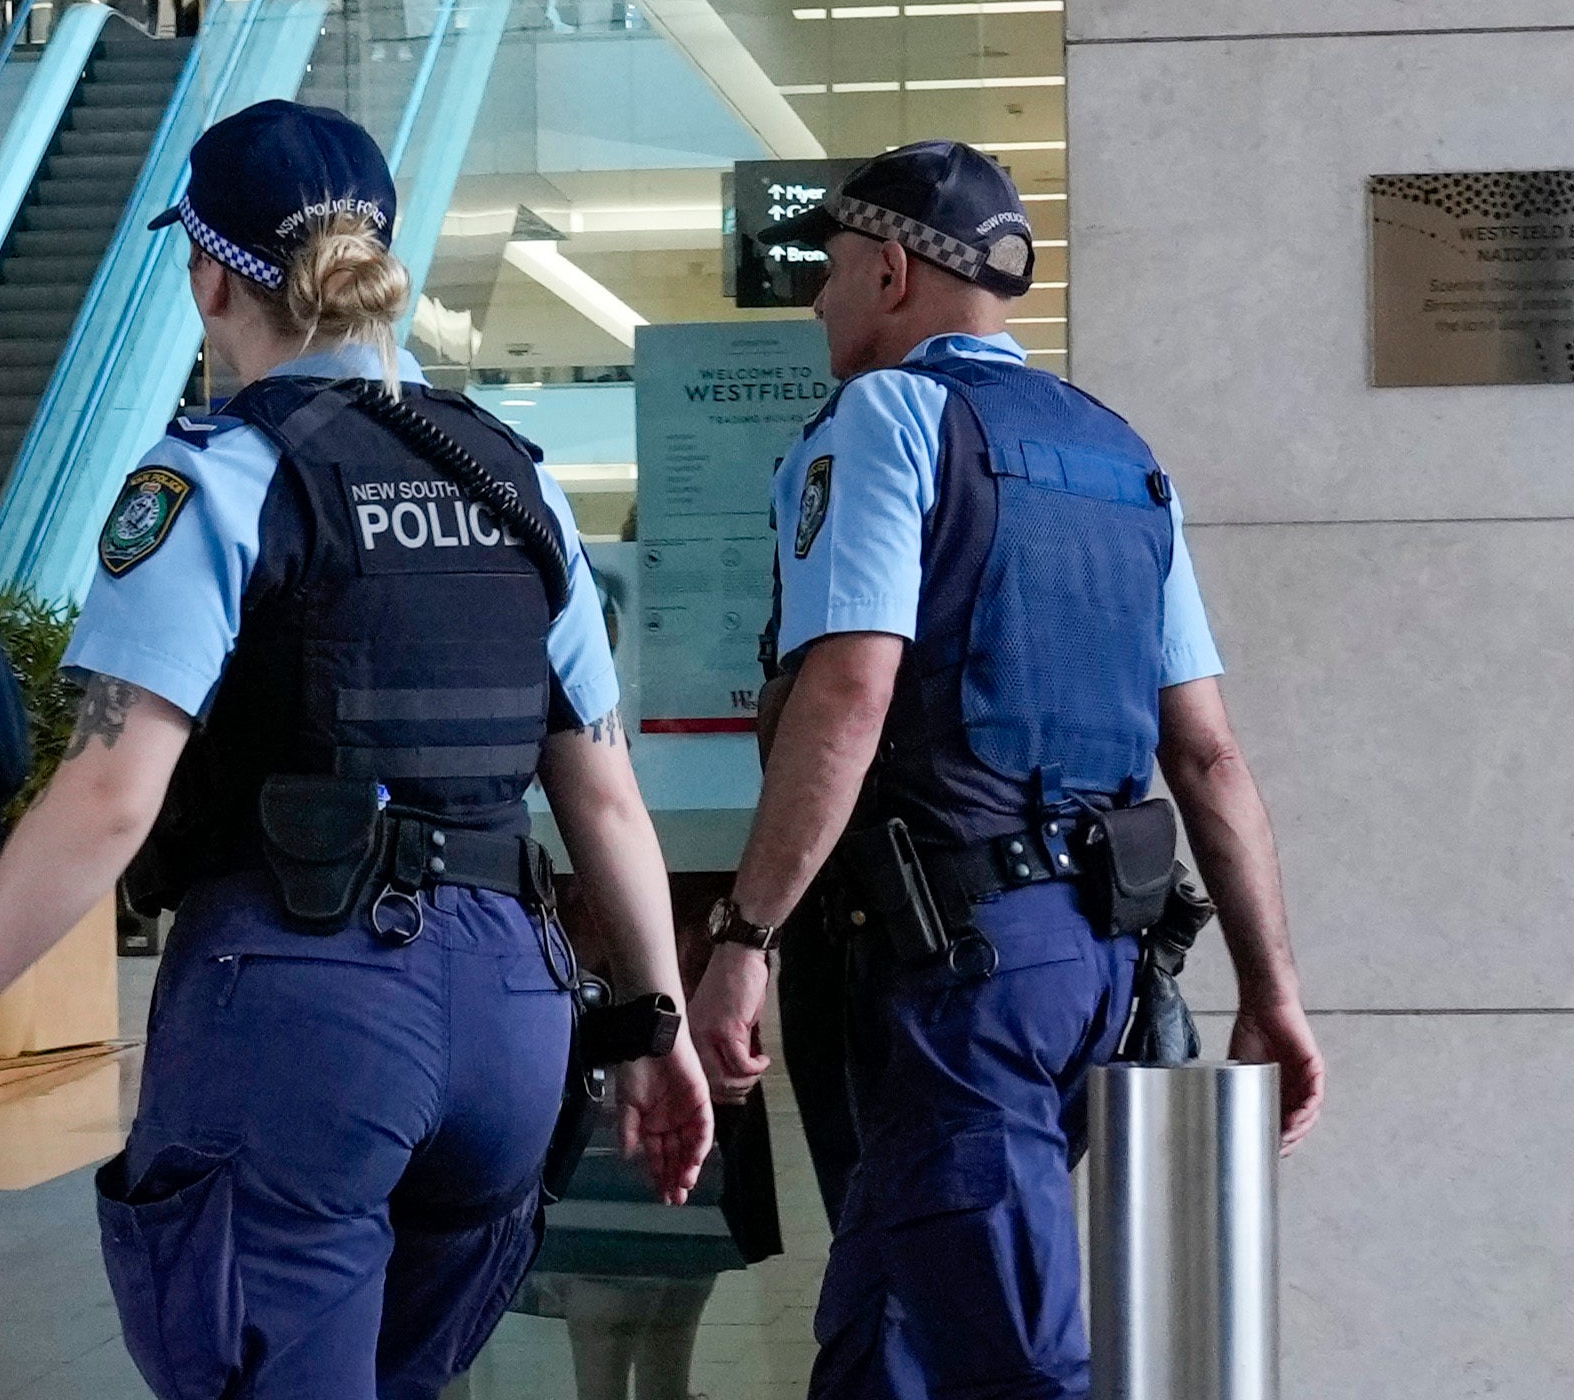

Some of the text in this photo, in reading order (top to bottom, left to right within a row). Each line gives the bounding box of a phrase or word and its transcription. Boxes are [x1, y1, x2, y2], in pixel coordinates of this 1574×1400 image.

[786, 185, 827, 204] Myer
[275, 210, 305, 239] NSW
[305, 199, 356, 219] POLICE
[975, 214, 1000, 236] NSW
[1459, 224, 1565, 241] WESTFIELD
[699, 366, 812, 380] WELCOME TO
[684, 381, 828, 403] WESTFIELD
[351, 482, 395, 501] NEW
[398, 480, 460, 499] SOUTH
